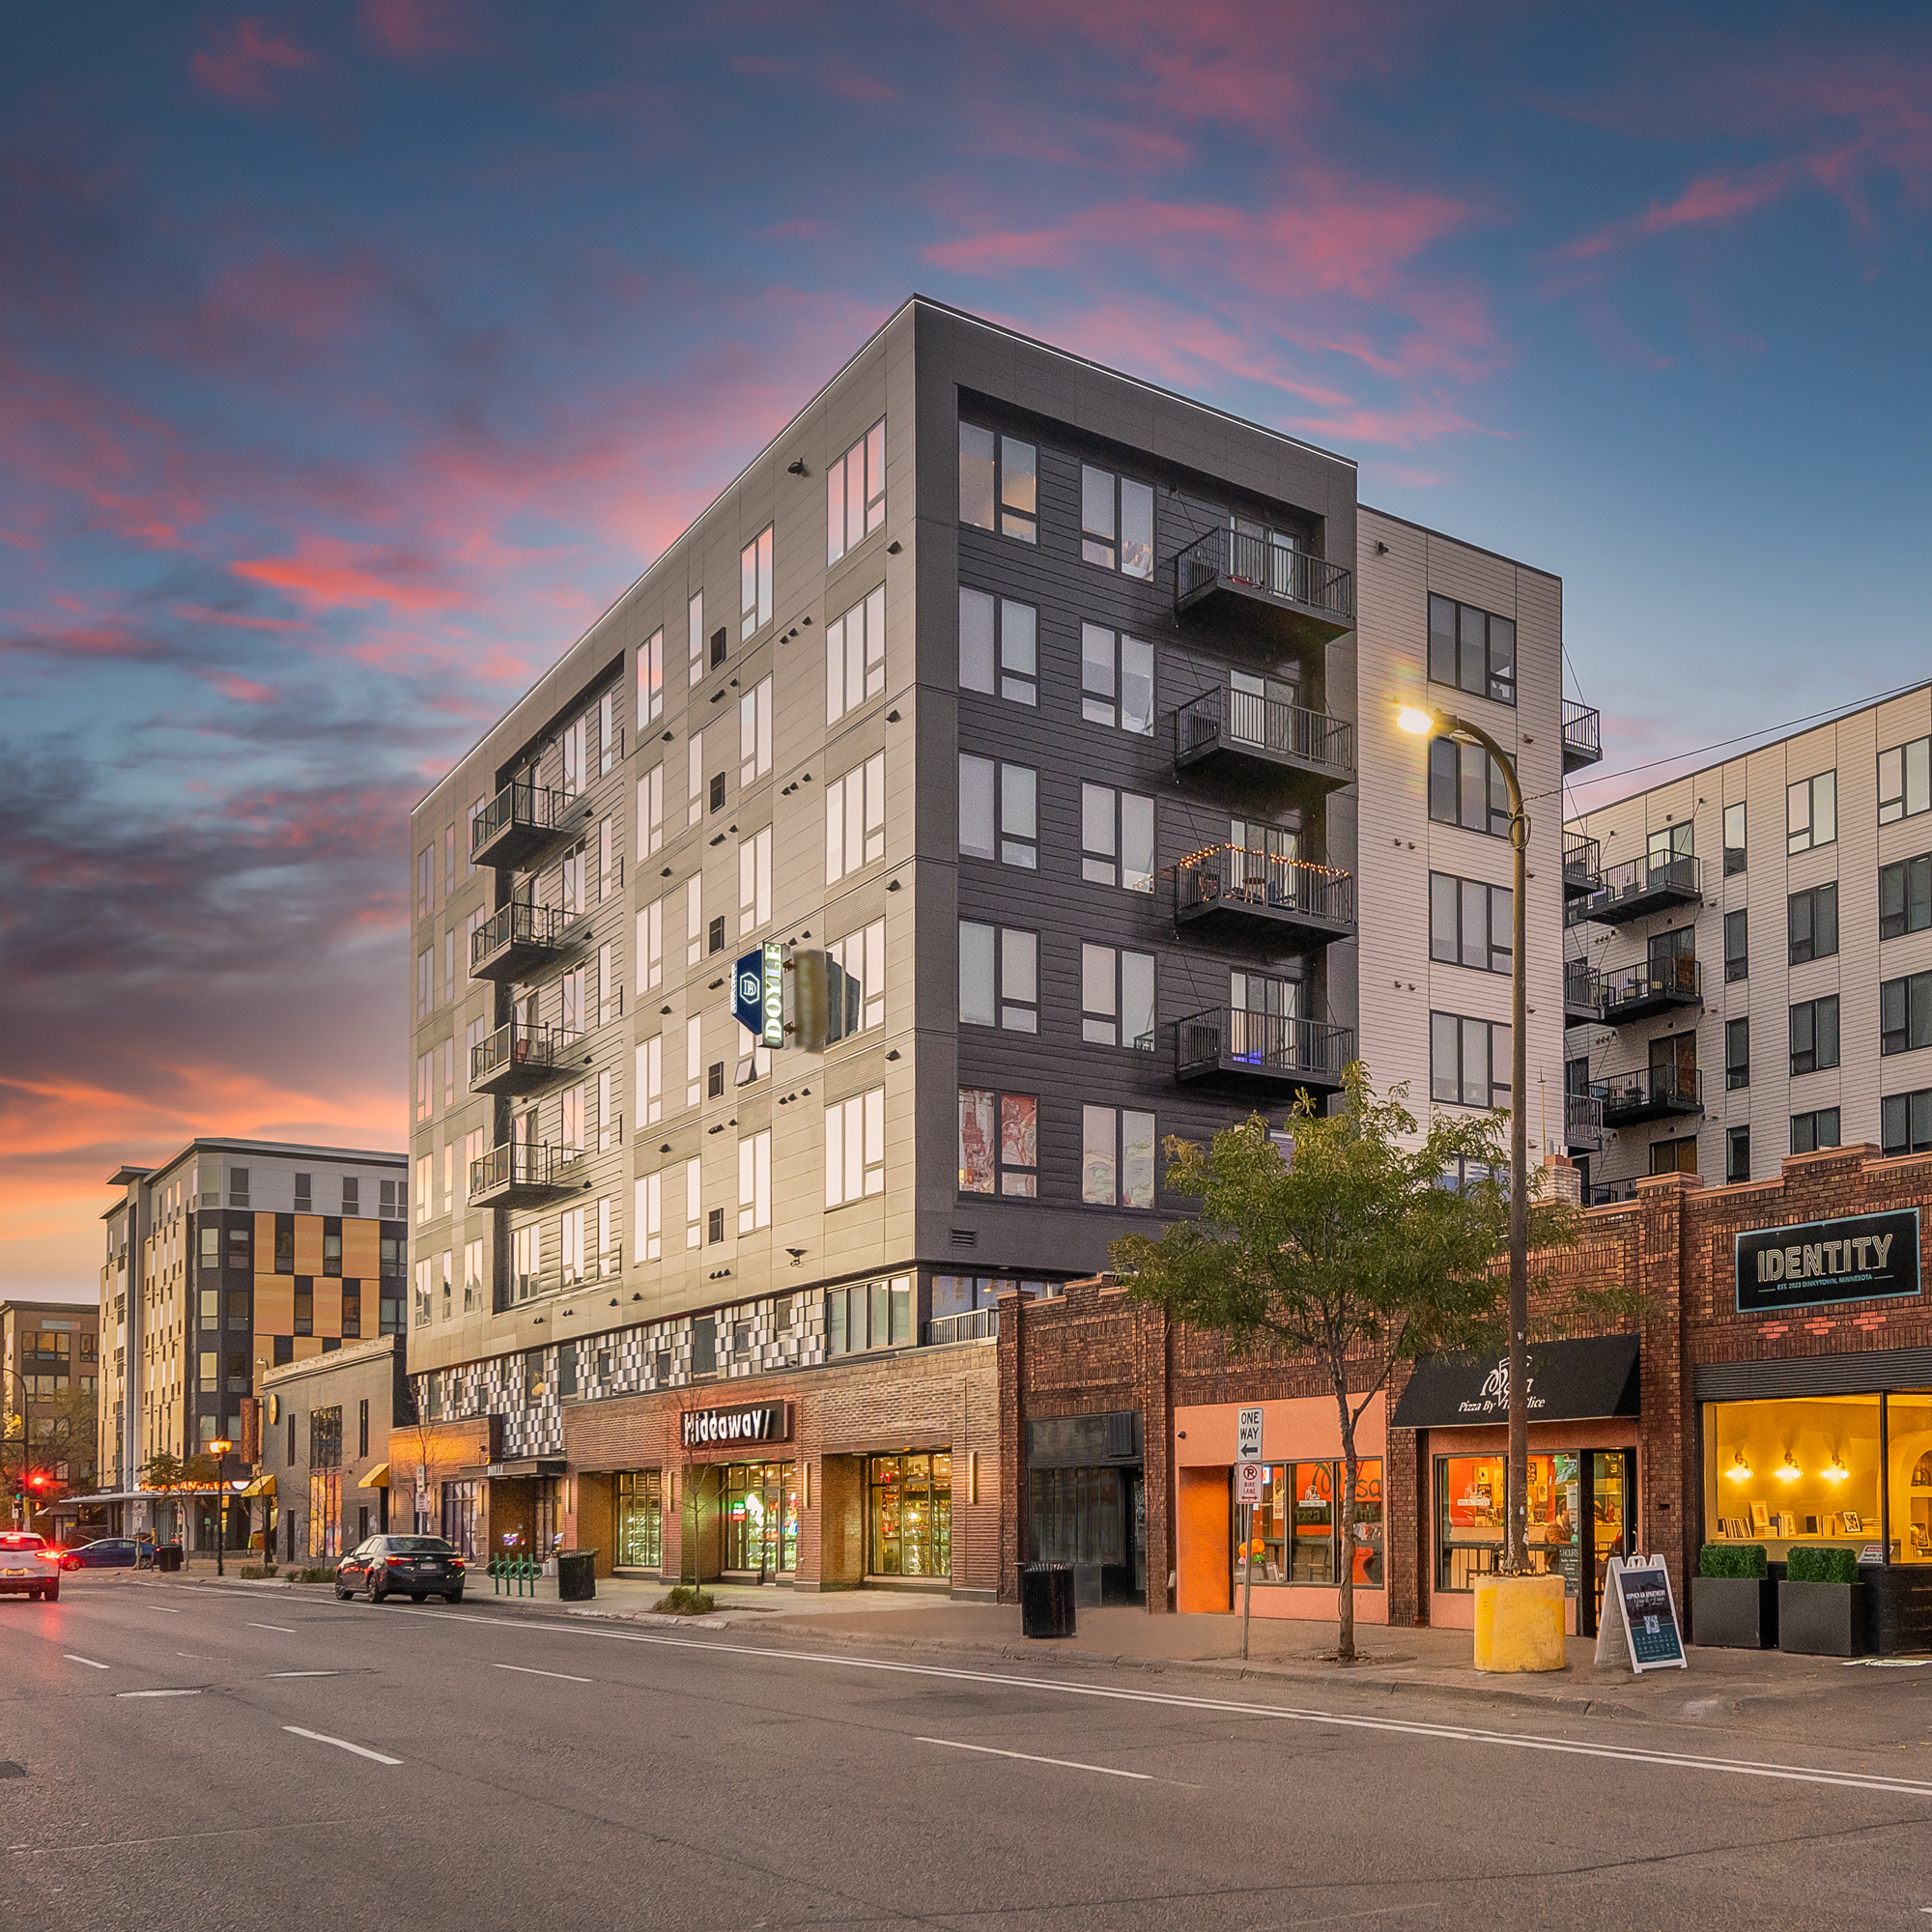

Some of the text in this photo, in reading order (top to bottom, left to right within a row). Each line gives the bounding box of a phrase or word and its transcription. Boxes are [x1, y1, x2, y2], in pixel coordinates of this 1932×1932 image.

[765, 943, 781, 1040] DOYLE
[1757, 1234, 1893, 1283] IDENTITY
[1803, 1277, 1837, 1288] DINKYTOWN,
[1839, 1273, 1873, 1283] MINNESOTA
[1458, 1400, 1482, 1412] Pizza
[1483, 1400, 1496, 1414] By
[1526, 1396, 1546, 1408] lice
[1240, 1411, 1260, 1425] ONE
[683, 1409, 763, 1446] Hideaway
[1239, 1427, 1260, 1440] WAY
[1562, 1548, 1579, 1557] HOURS
